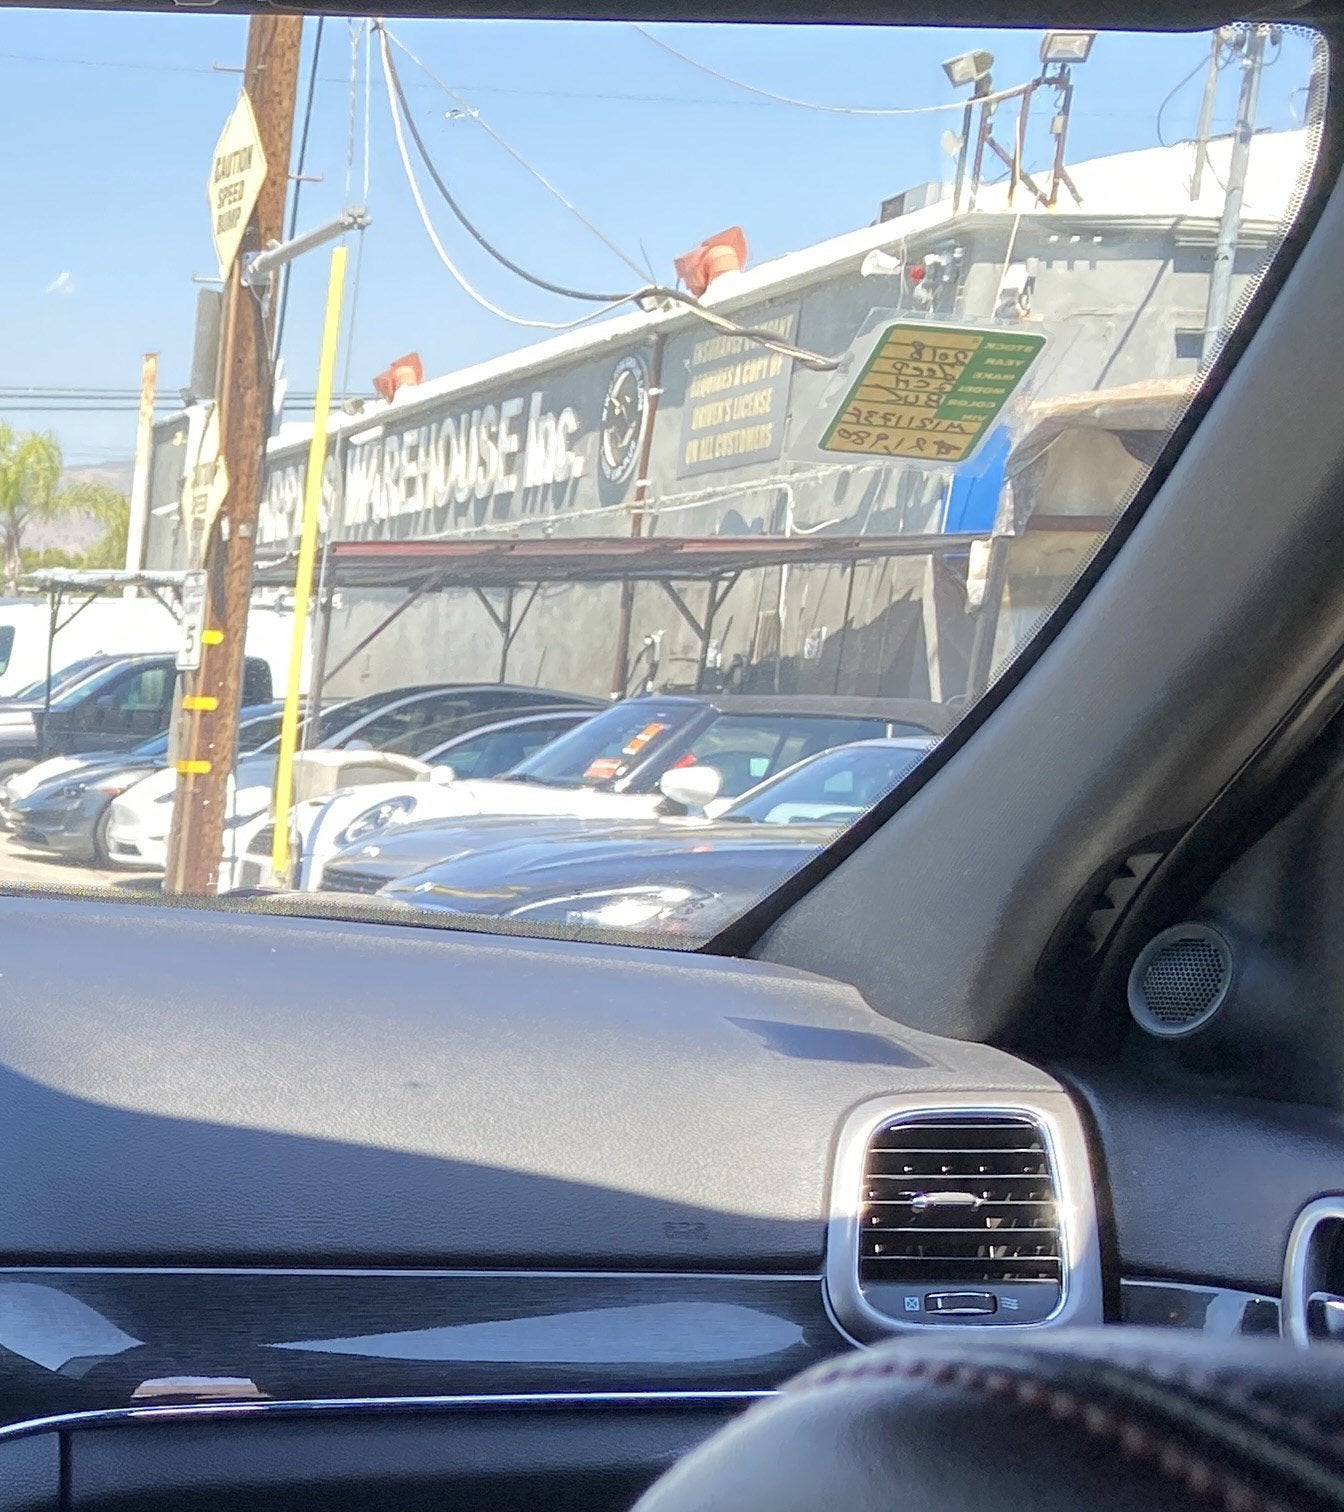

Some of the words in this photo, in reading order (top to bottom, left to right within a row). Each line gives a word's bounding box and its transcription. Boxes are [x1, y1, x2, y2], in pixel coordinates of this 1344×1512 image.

[214, 144, 253, 183] CAUTION
[218, 180, 244, 209] SPEED
[344, 397, 523, 525] WAREHOUSE
[522, 391, 584, 488] Inc.
[185, 626, 196, 654] 5
